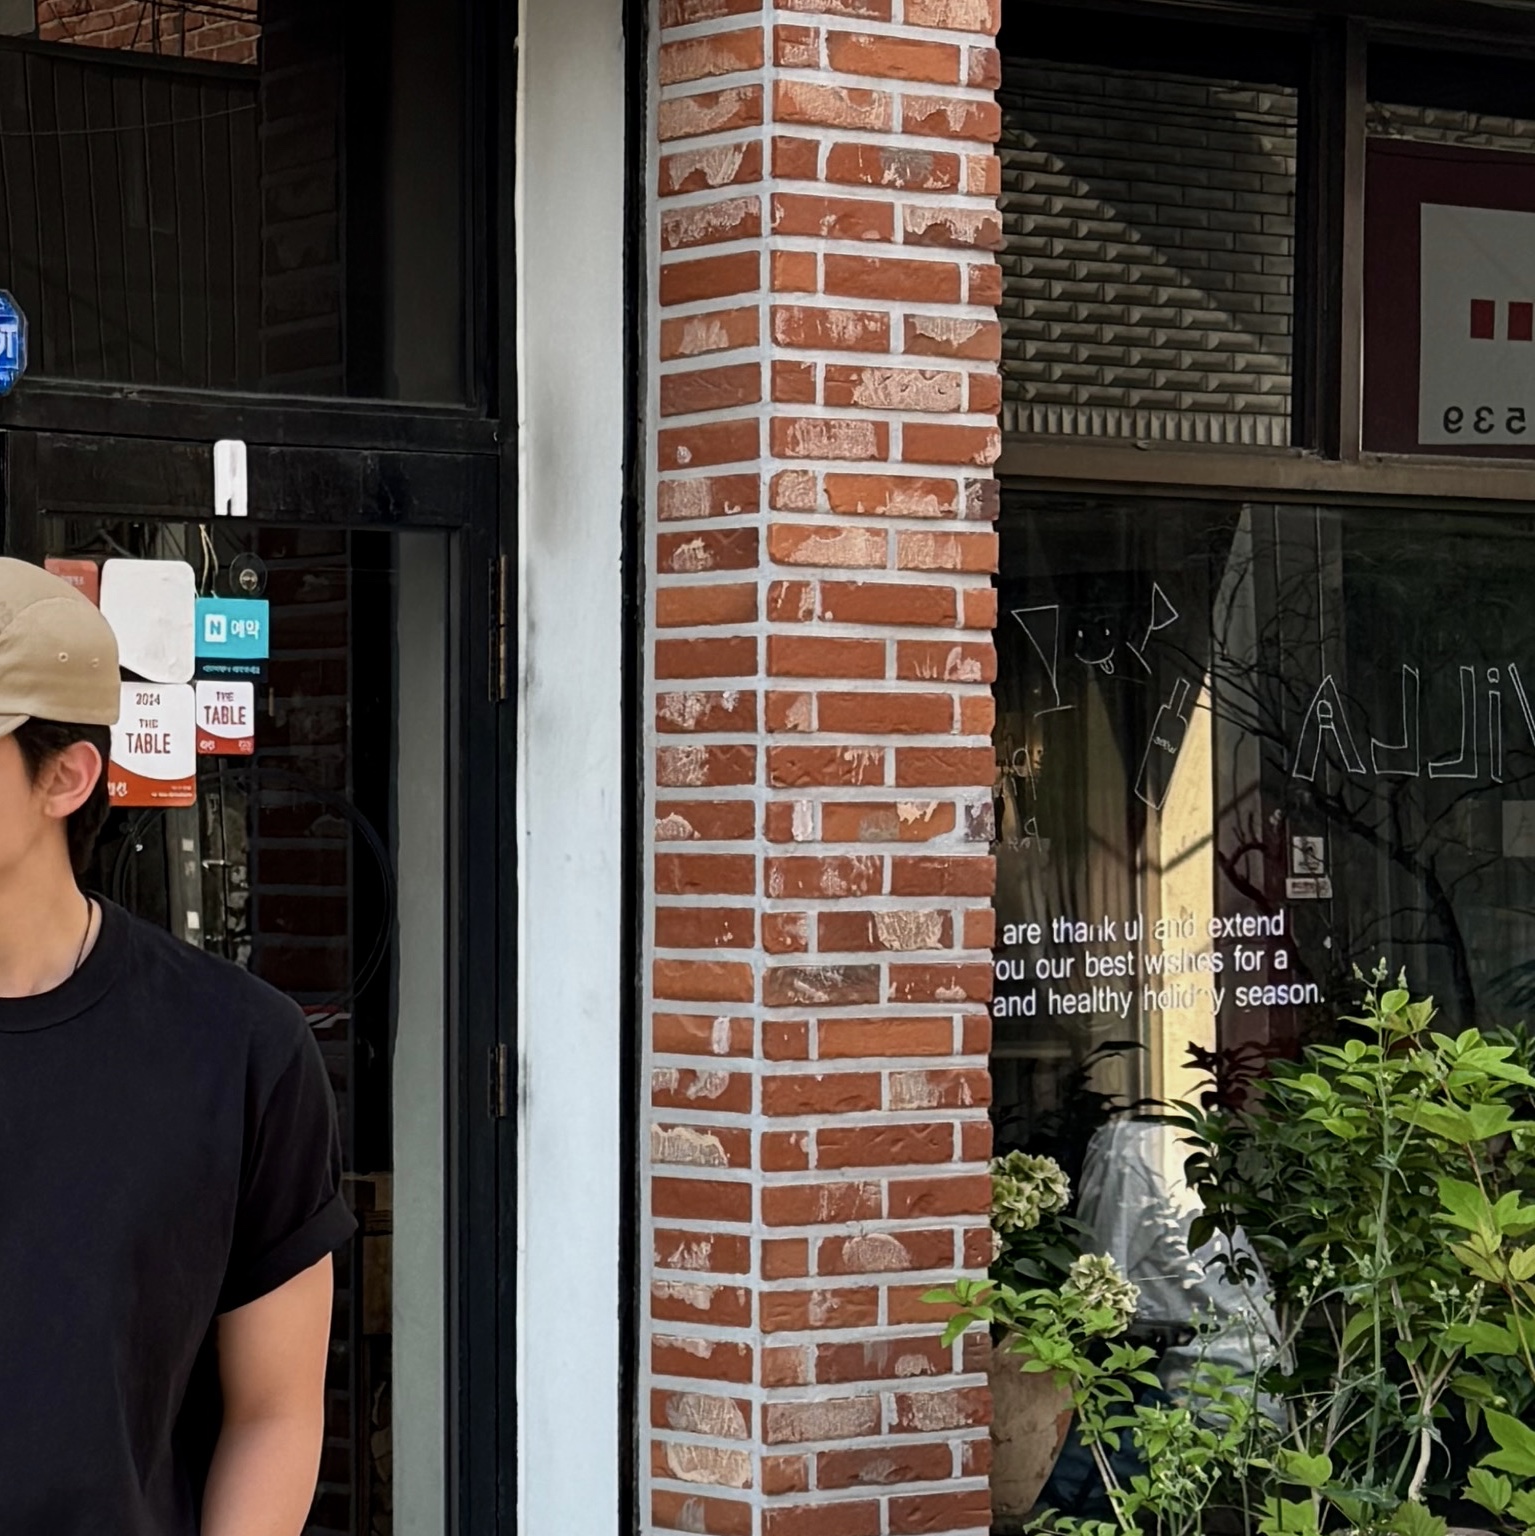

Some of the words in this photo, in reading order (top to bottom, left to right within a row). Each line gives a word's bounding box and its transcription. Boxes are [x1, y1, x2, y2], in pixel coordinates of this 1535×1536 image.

[231, 619, 260, 640] 예약
[203, 705, 247, 725] TABLE
[125, 732, 171, 754] TABLE
[1003, 923, 1041, 945] are
[1208, 908, 1284, 938] extend
[1035, 957, 1076, 979] our
[1085, 950, 1135, 977] best
[1234, 945, 1265, 972] for
[1273, 949, 1288, 970] a
[993, 988, 1037, 1017] and
[1048, 985, 1133, 1019] healthy
[1236, 983, 1326, 1008] season.
